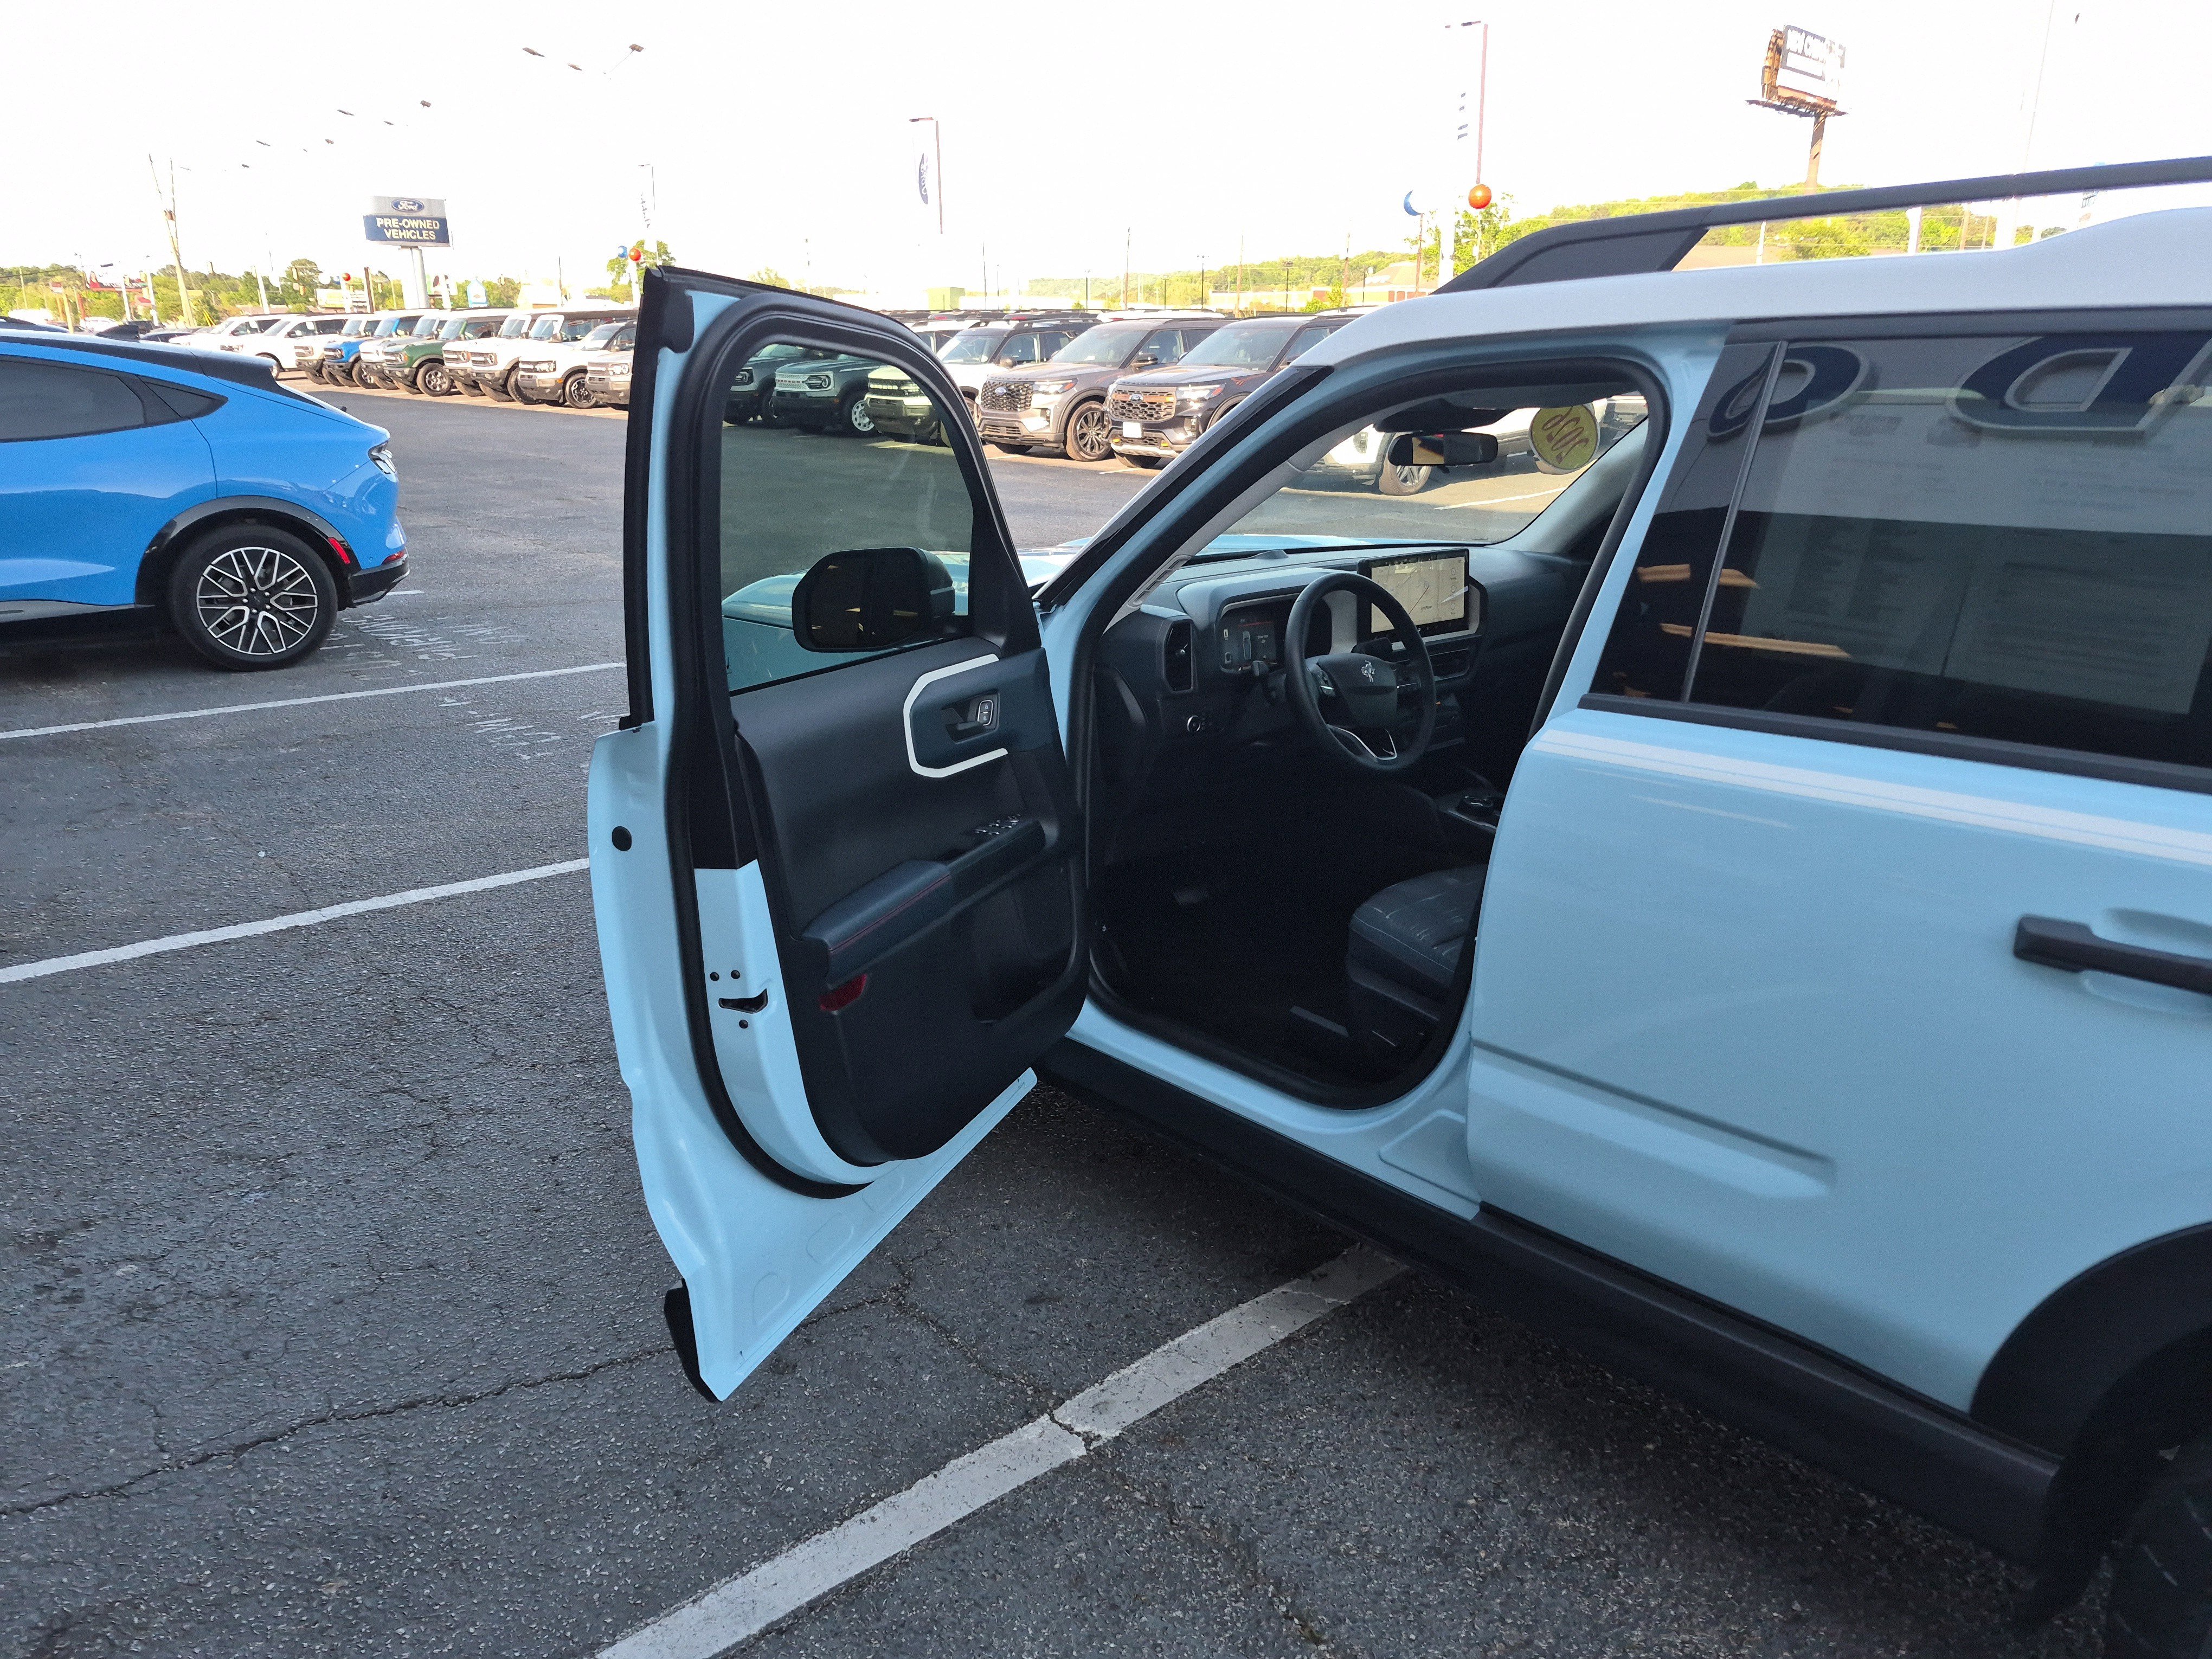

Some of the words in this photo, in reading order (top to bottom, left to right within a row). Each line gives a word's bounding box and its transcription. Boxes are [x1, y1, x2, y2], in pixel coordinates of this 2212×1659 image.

[397, 201, 418, 210] Ford
[376, 217, 440, 229] PRE-OWNED
[384, 229, 436, 240] VEHICLES
